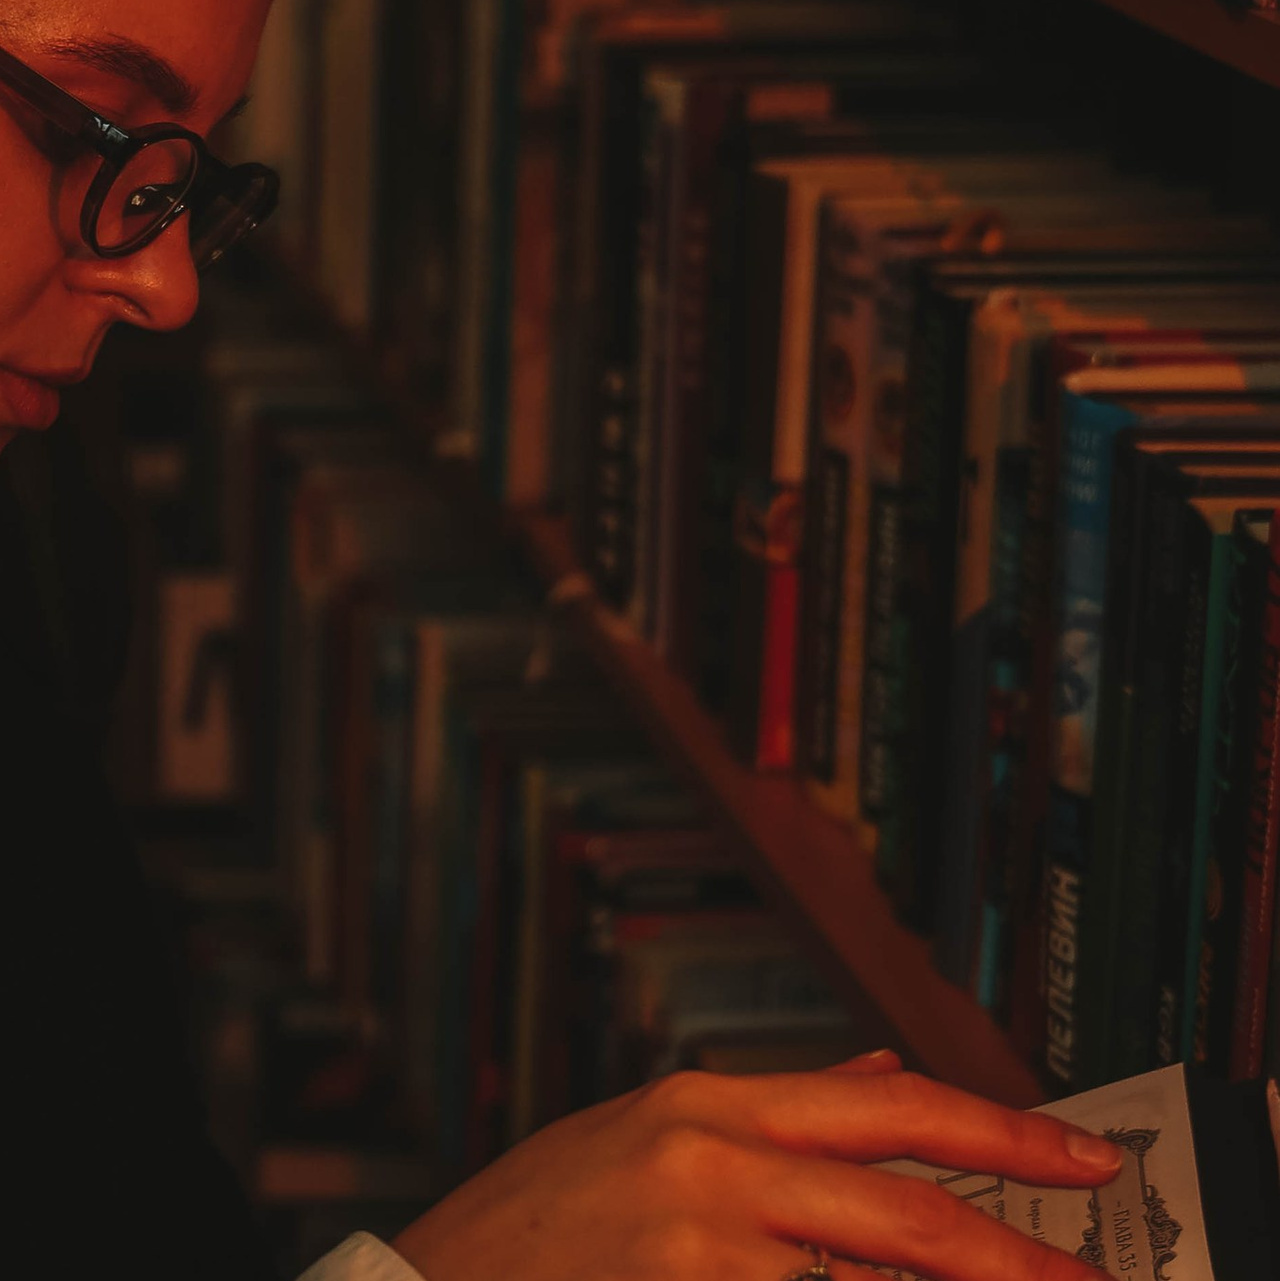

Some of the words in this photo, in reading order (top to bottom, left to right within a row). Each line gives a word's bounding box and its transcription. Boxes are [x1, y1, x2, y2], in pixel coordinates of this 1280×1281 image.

[1045, 862, 1082, 1082] ПЕЛЕВИН
[1113, 1209, 1133, 1252] ГЛАВА
[1119, 1252, 1136, 1272] 35
